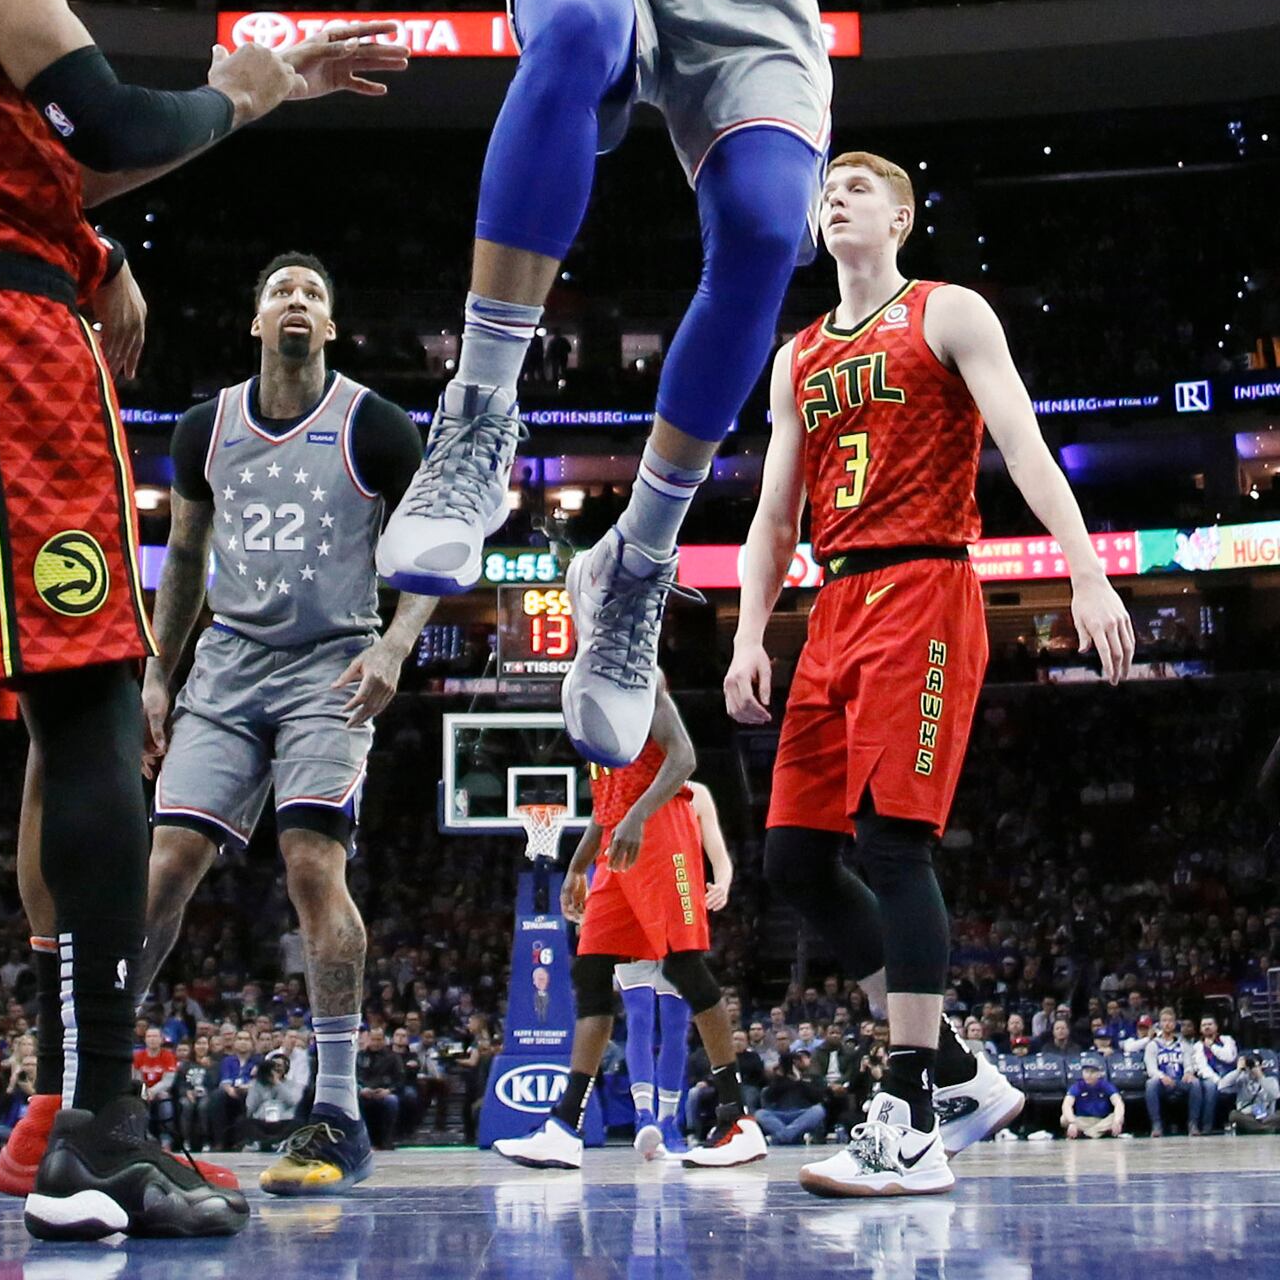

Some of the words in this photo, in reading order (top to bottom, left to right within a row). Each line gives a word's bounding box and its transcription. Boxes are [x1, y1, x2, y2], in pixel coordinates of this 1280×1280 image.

[297, 19, 461, 53] TOTA
[801, 351, 907, 434] ATL
[835, 432, 869, 510] 3
[242, 503, 306, 552] 22
[484, 552, 557, 582] 8:55
[531, 616, 570, 655] 13
[914, 638, 948, 776] HAWKS
[672, 853, 694, 925] HAWKS
[511, 1073, 570, 1103] KIA
